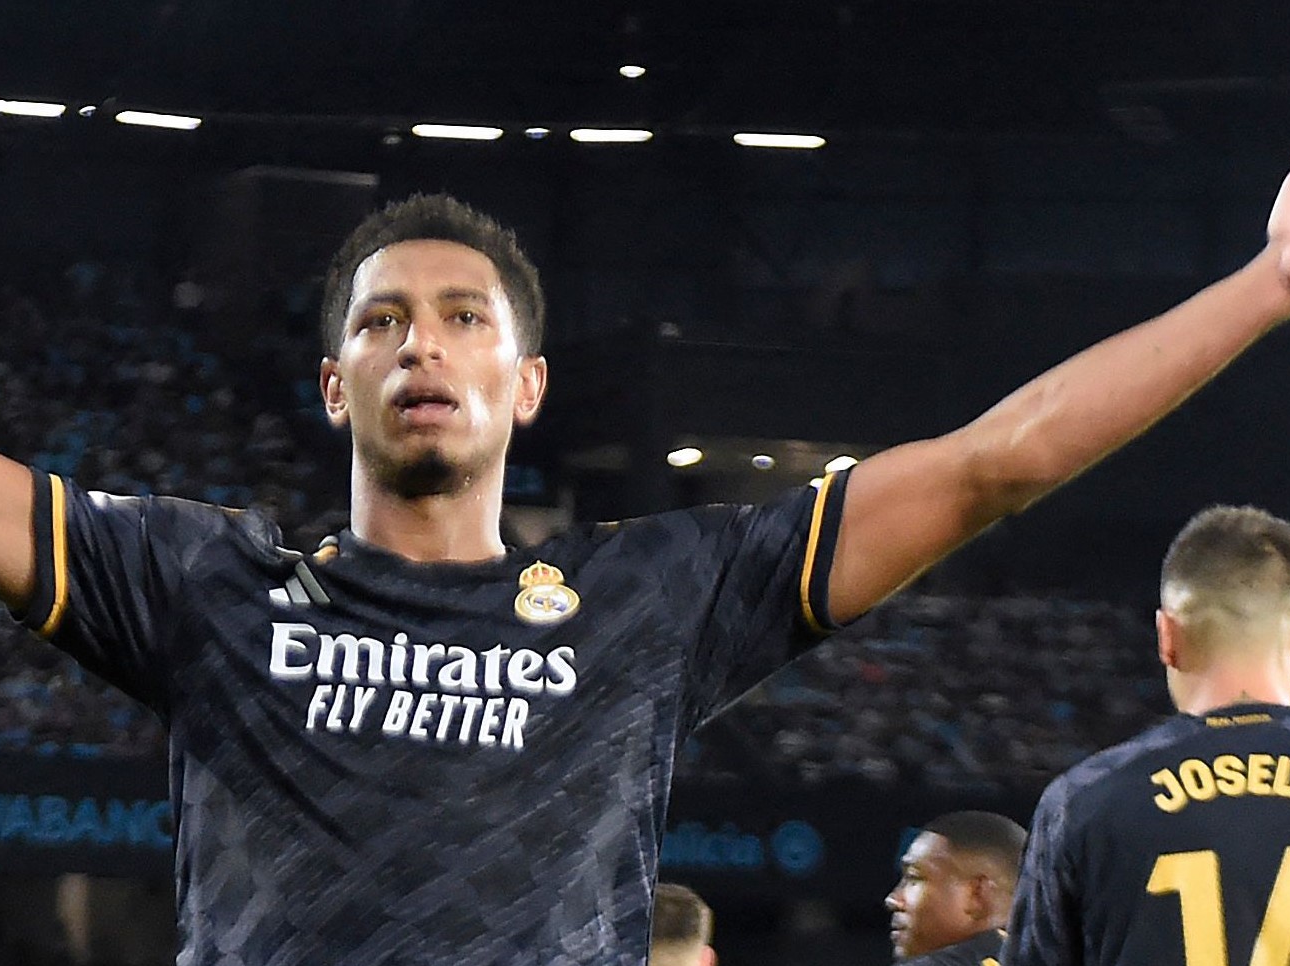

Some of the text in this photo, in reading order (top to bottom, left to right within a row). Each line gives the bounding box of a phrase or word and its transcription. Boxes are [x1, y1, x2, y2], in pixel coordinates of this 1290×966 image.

[268, 621, 578, 695] Emirates
[306, 683, 530, 749] FLY BETTER
